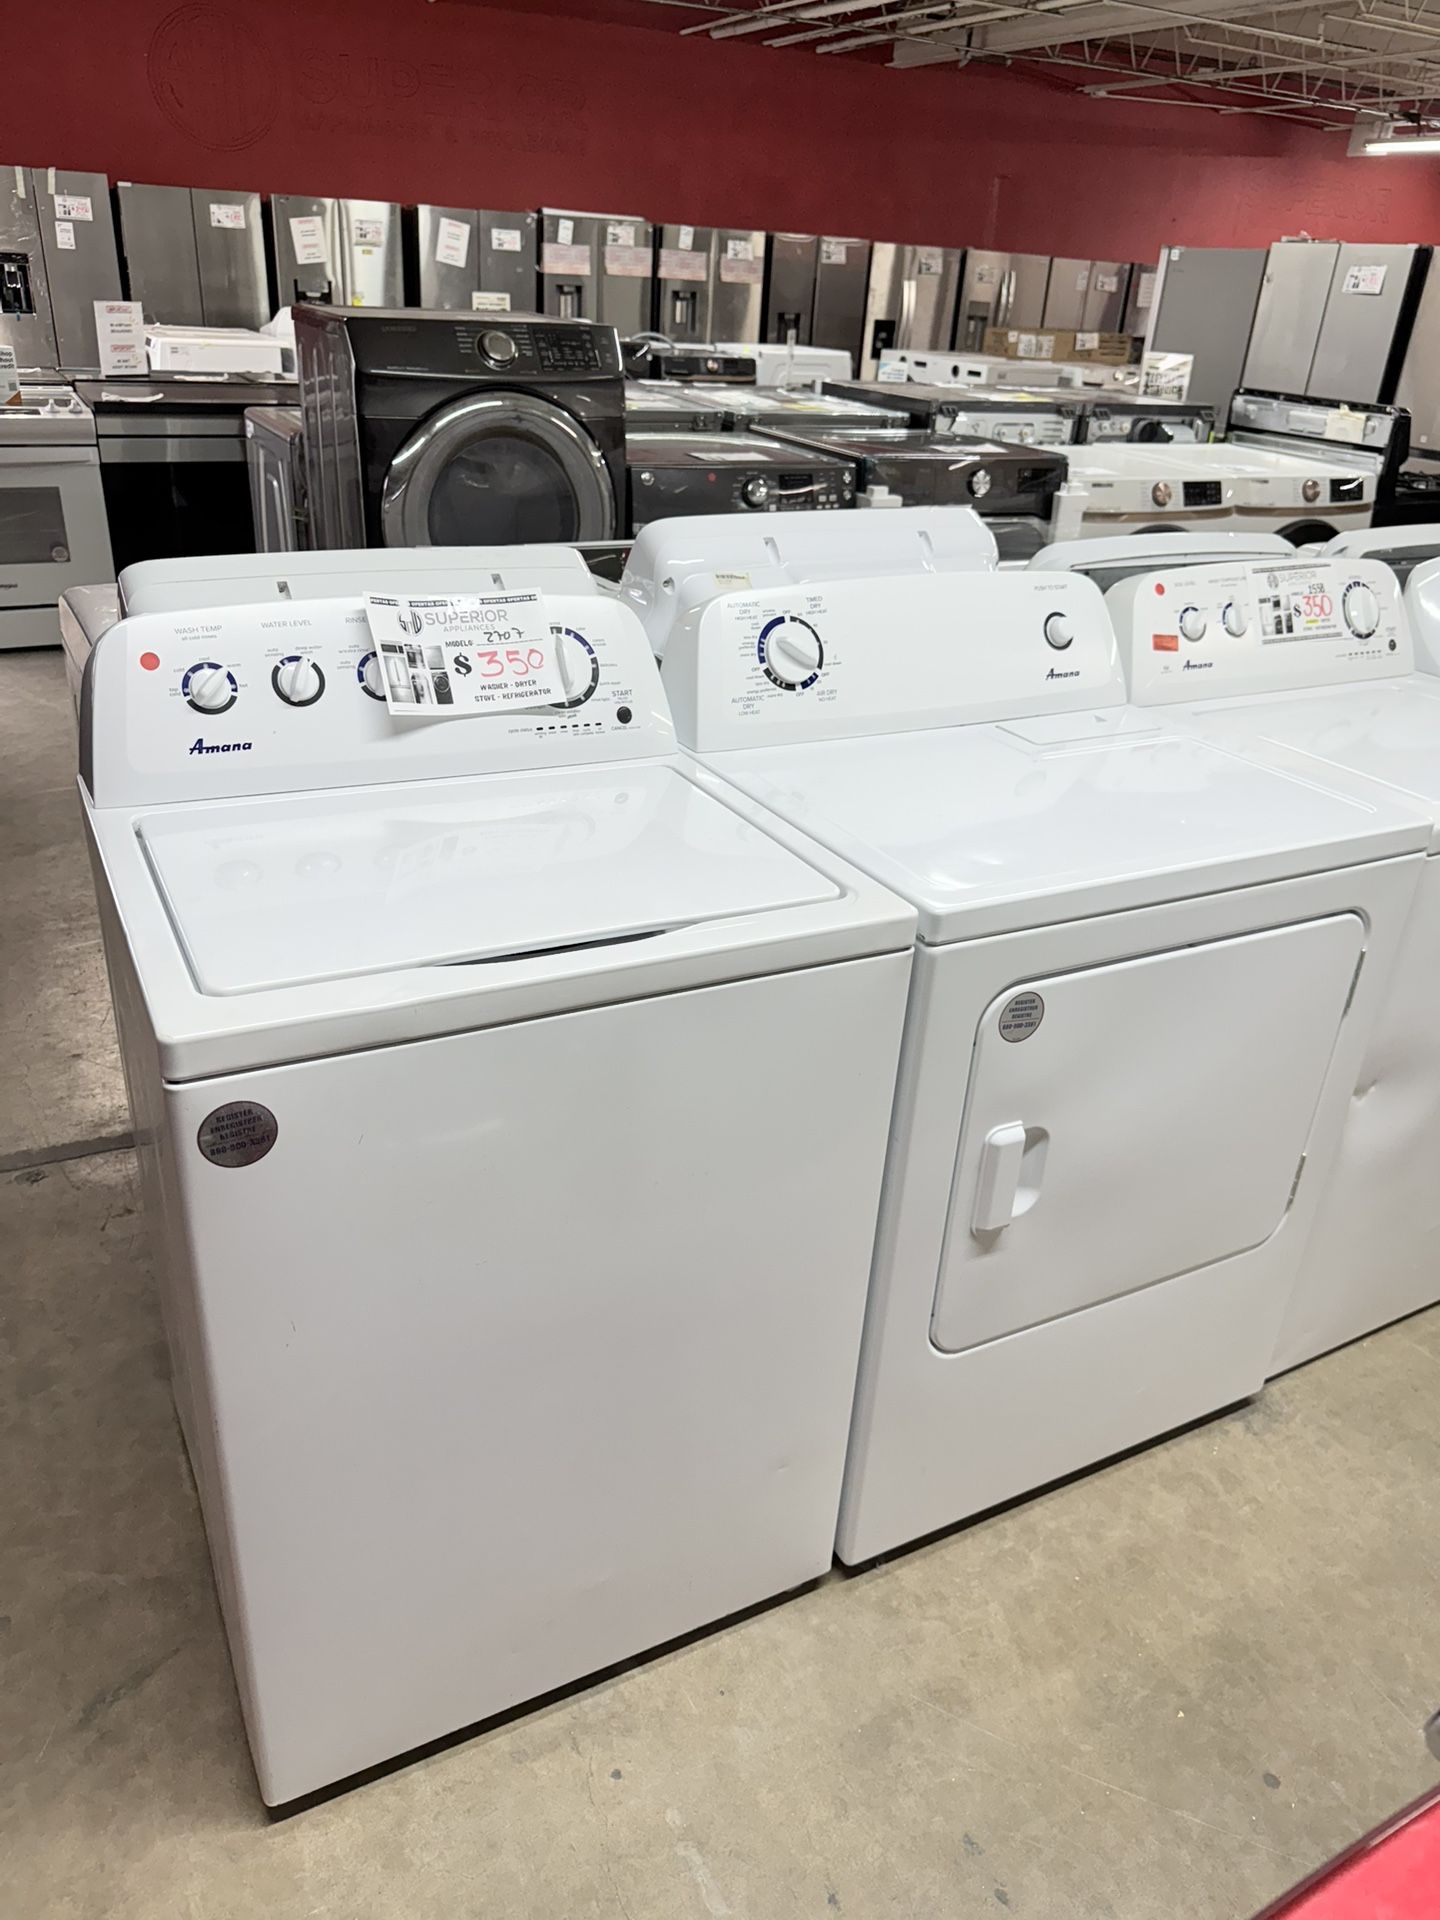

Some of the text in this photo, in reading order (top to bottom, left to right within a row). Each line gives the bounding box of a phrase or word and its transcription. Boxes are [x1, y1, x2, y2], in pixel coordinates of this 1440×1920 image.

[1294, 595, 1332, 617] $ 350
[424, 609, 508, 625] SUPERIOR
[174, 627, 199, 635] WASH
[444, 624, 496, 632] APPLIANCES
[454, 649, 544, 678] $ 350
[1183, 659, 1213, 671] Amana
[1046, 668, 1080, 680] Amana
[480, 680, 537, 691] WASHER DRYER
[475, 689, 551, 702] STOVE REFRIGERATOR
[731, 696, 765, 704] AUTOMATIC
[189, 738, 252, 754] Amana
